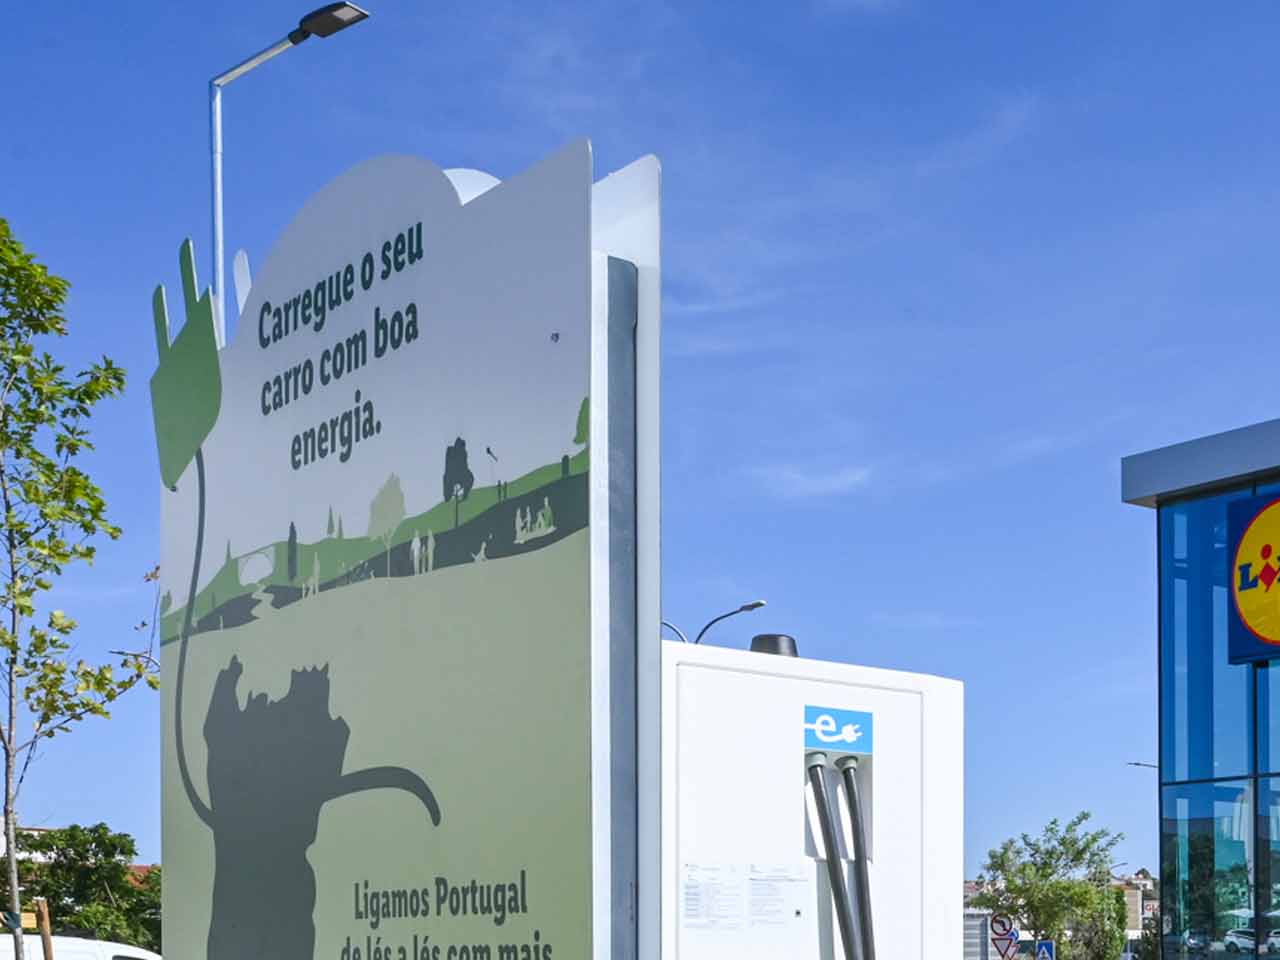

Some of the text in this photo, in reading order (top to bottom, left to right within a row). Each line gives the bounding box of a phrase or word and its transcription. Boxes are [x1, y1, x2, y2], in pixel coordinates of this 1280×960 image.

[259, 221, 424, 349] Carregue o seu
[261, 302, 418, 416] carro com boa
[290, 389, 381, 470] energia.
[354, 869, 528, 930] Ligamos Portugal
